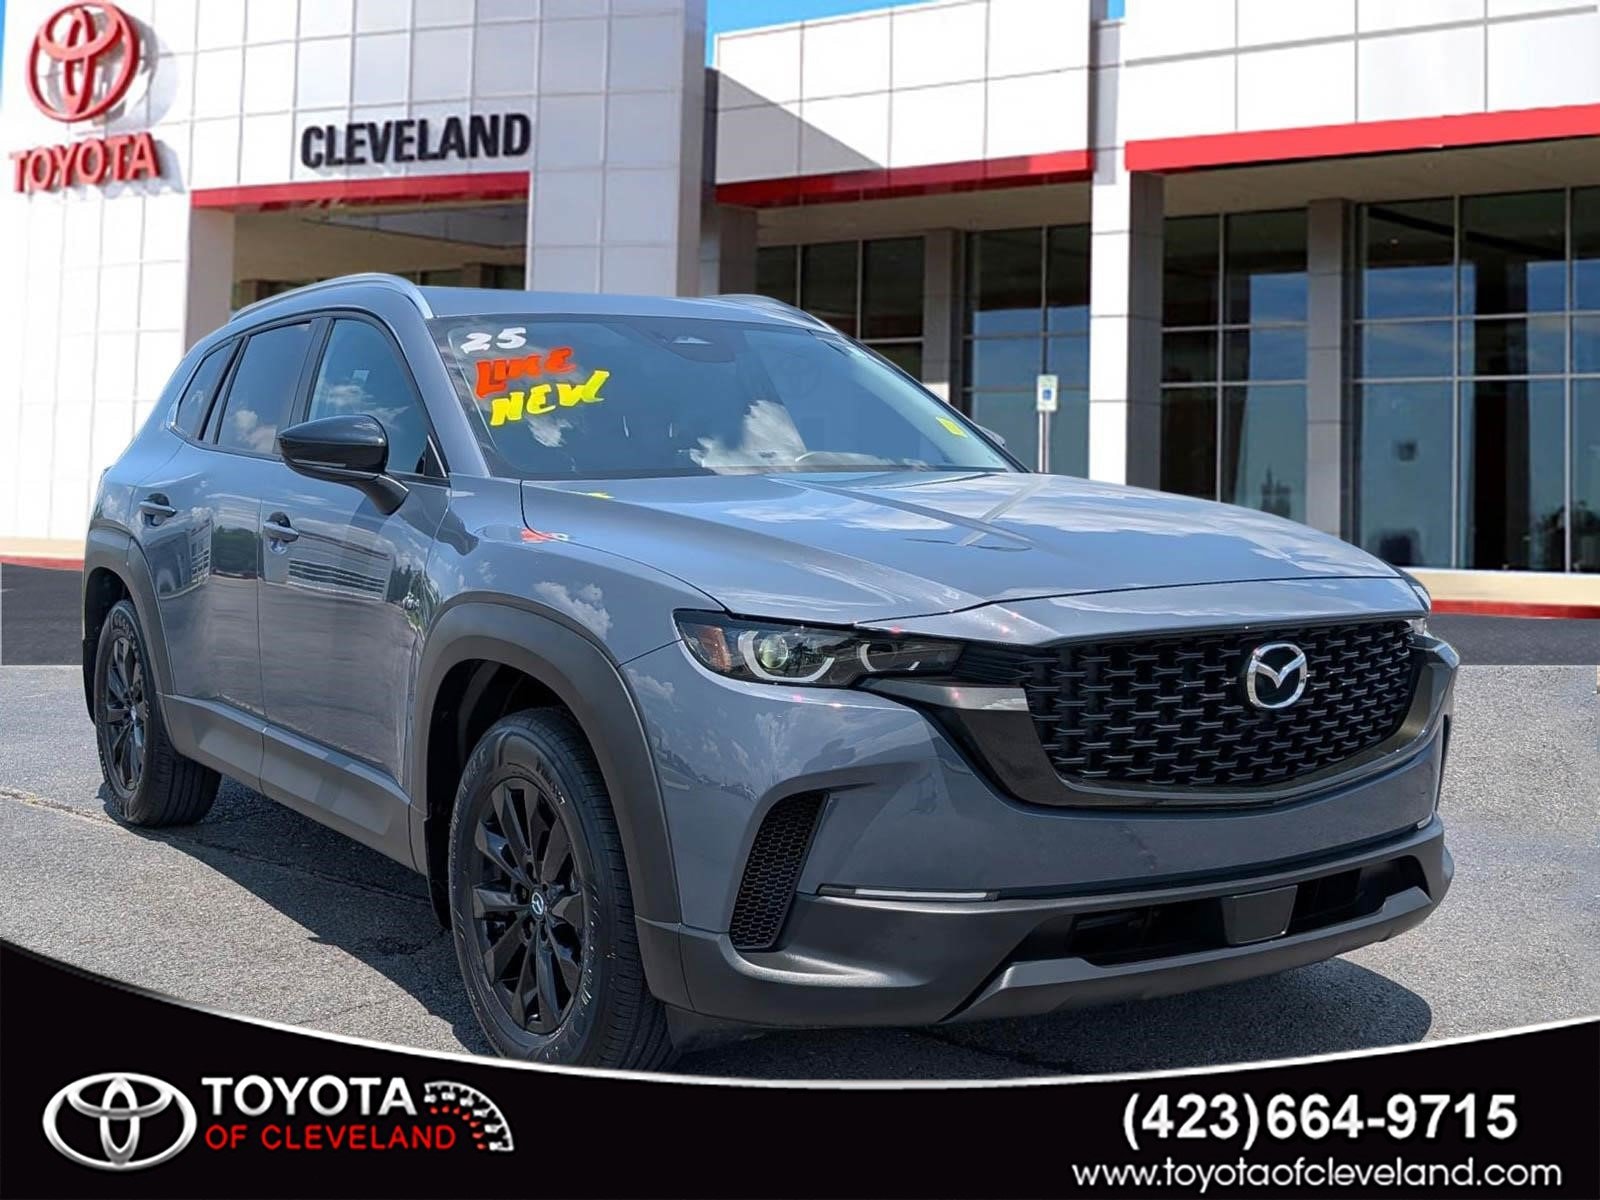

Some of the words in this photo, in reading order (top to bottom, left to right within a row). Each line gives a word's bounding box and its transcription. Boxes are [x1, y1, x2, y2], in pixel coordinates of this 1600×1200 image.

[9, 132, 161, 193] TOYOTA
[301, 113, 531, 169] CLEVELAND
[460, 326, 527, 354] 25
[490, 370, 610, 426] NEW
